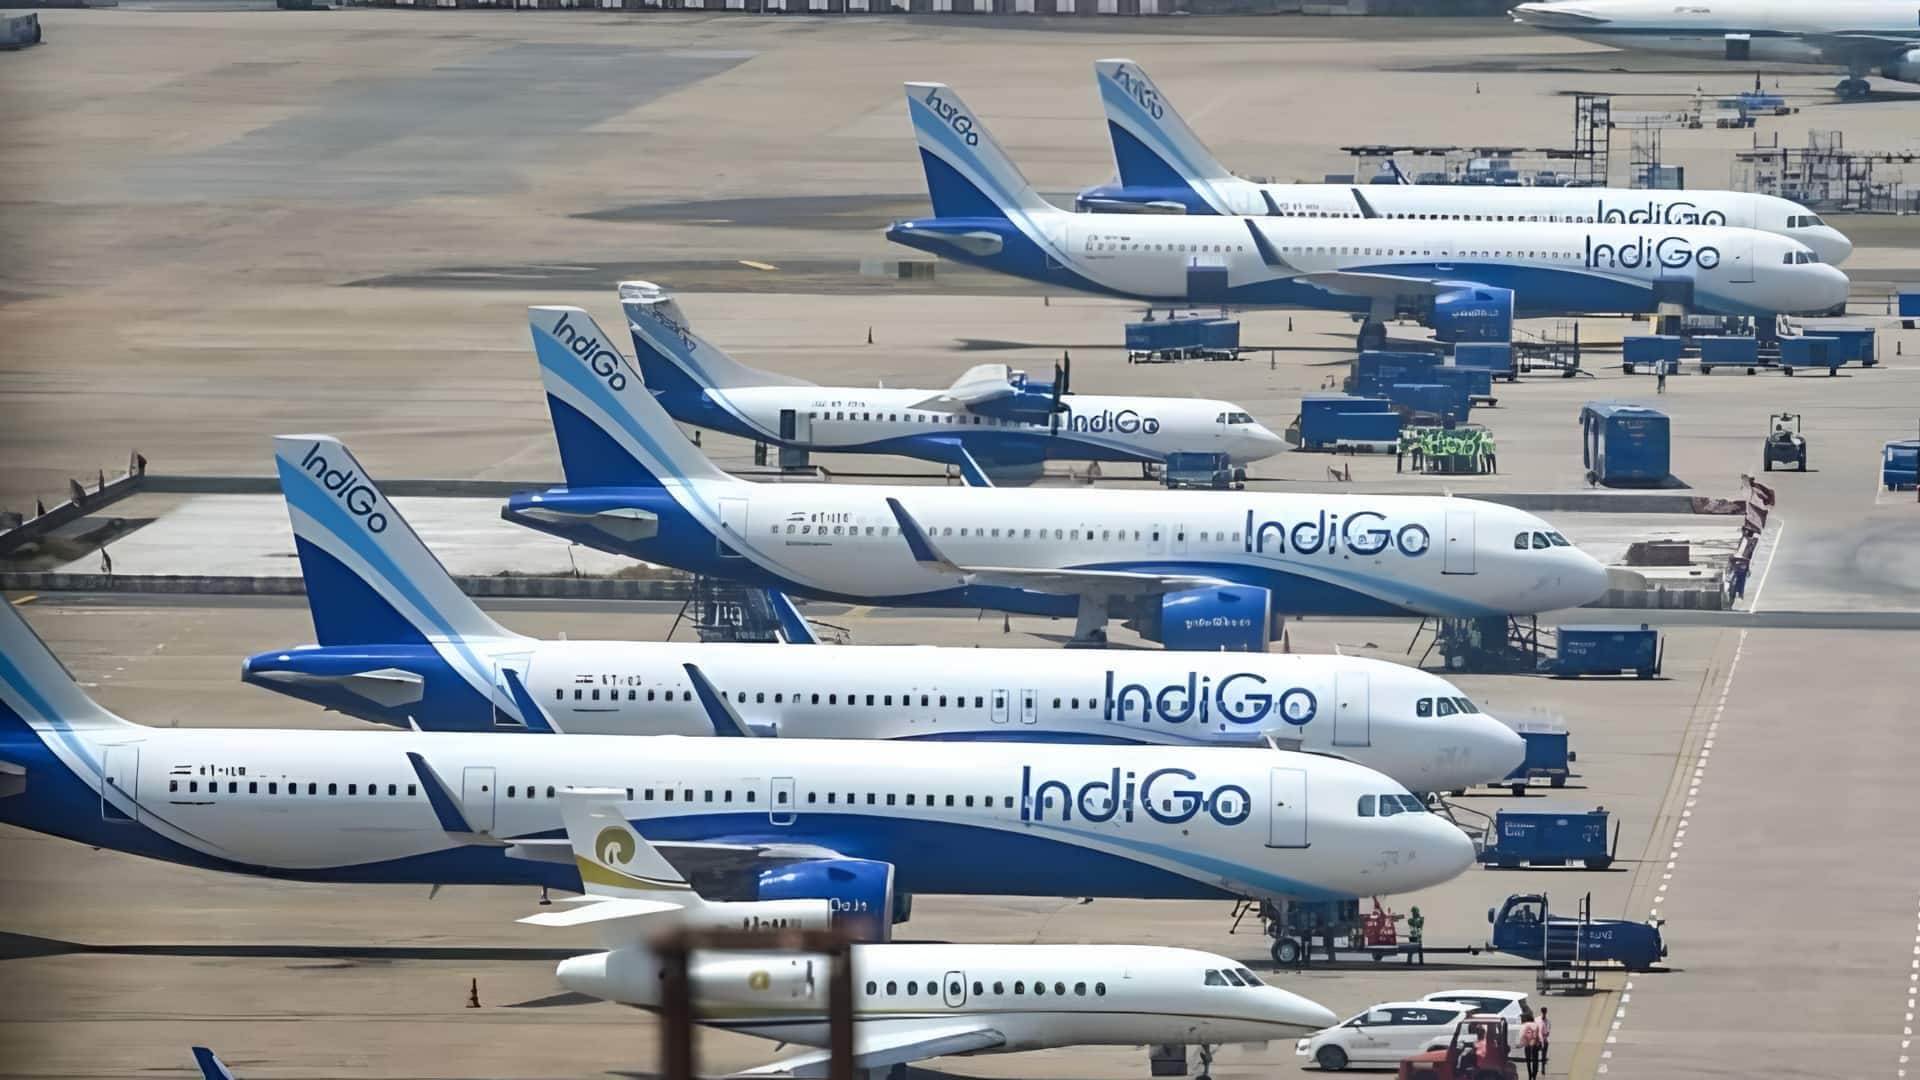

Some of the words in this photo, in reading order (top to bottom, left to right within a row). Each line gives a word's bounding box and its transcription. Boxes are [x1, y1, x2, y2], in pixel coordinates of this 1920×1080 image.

[1585, 235, 1721, 270] IndiGo
[551, 312, 627, 392] IndiGo
[1066, 409, 1160, 435] IndiGo
[302, 441, 388, 534] IndiGo
[1245, 510, 1430, 558] IndiGo
[1104, 670, 1317, 726] IndiGo
[1021, 766, 1252, 826] IndiGo
